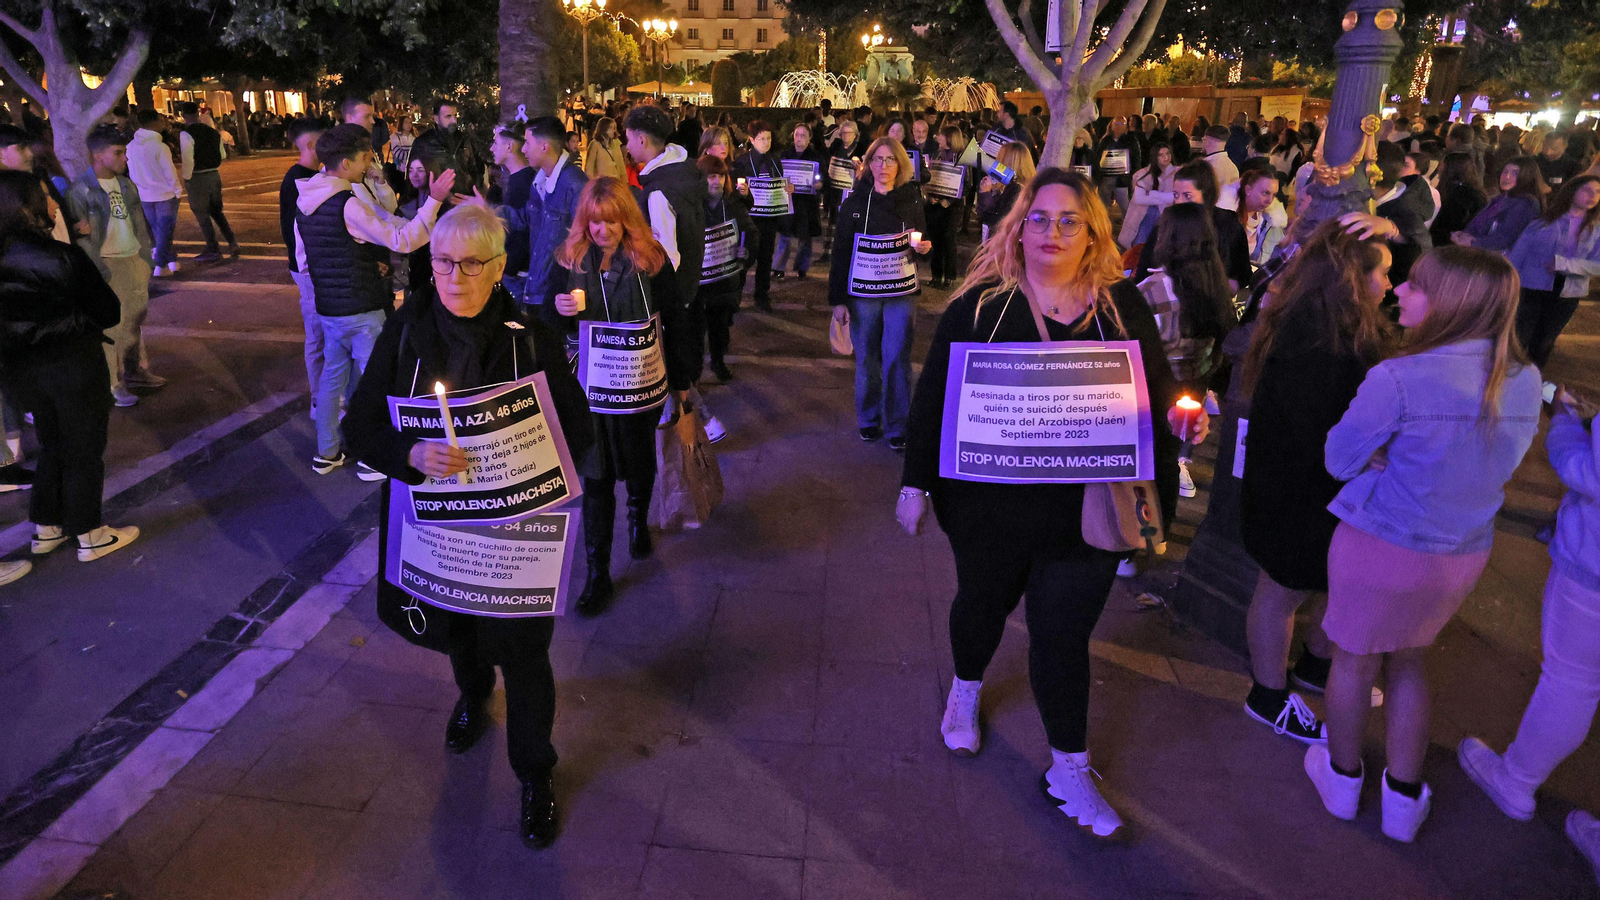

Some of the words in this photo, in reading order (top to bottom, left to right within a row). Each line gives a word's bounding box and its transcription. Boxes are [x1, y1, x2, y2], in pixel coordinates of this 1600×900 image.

[596, 334, 626, 346] VANESA
[628, 337, 646, 346] S.P.
[602, 354, 629, 362] Asesinada
[1014, 361, 1044, 370] GÓMEZ
[1046, 361, 1093, 370] FERNÁNDEZ
[589, 392, 607, 402] STOP
[608, 393, 649, 403] VIOLENCIA
[970, 390, 1016, 401] Asesinada
[1028, 392, 1050, 402] tiros
[1053, 394, 1070, 403] por
[1087, 391, 1123, 400] marido,
[401, 415, 421, 428] EVA
[466, 411, 495, 426] AZA
[496, 404, 510, 418] 46
[512, 397, 534, 412] años
[983, 403, 1009, 413] quién
[1026, 403, 1063, 414] suicidó
[1066, 404, 1107, 415] después
[968, 414, 1016, 426] Villanueva
[1019, 416, 1035, 426] del
[1038, 417, 1092, 428] Arzobispo
[1095, 416, 1126, 427] (Jaén)
[502, 436, 513, 445] un
[514, 431, 527, 440] tiro
[528, 426, 536, 434] en
[537, 422, 543, 430] el
[1000, 429, 1061, 440] Septiembre
[1065, 430, 1090, 439] 2023
[492, 449, 511, 460] deja
[513, 445, 518, 453] 2
[520, 438, 537, 450] hijos
[538, 433, 546, 442] de
[960, 451, 992, 465] STOP
[994, 454, 1064, 468] VIOLENCIA
[1066, 455, 1134, 467] MACHISTA
[473, 465, 482, 473] 13
[485, 462, 507, 472] años
[477, 474, 502, 483] María
[510, 462, 536, 477] Cádiz)
[415, 500, 443, 511] STOP
[443, 498, 506, 511] VIOLENCIA
[506, 476, 564, 504] MACHISTA
[524, 523, 557, 533] años
[418, 534, 437, 548] hasta
[449, 546, 479, 557] muerte
[481, 552, 496, 560] por
[479, 542, 512, 552] cuchillo
[431, 550, 470, 564] Castellón
[438, 562, 489, 578] Septiembre
[491, 572, 513, 580] 2023
[403, 568, 427, 587] STOP
[429, 582, 489, 604] VIOLENCIA
[491, 595, 552, 605] MACHISTA
